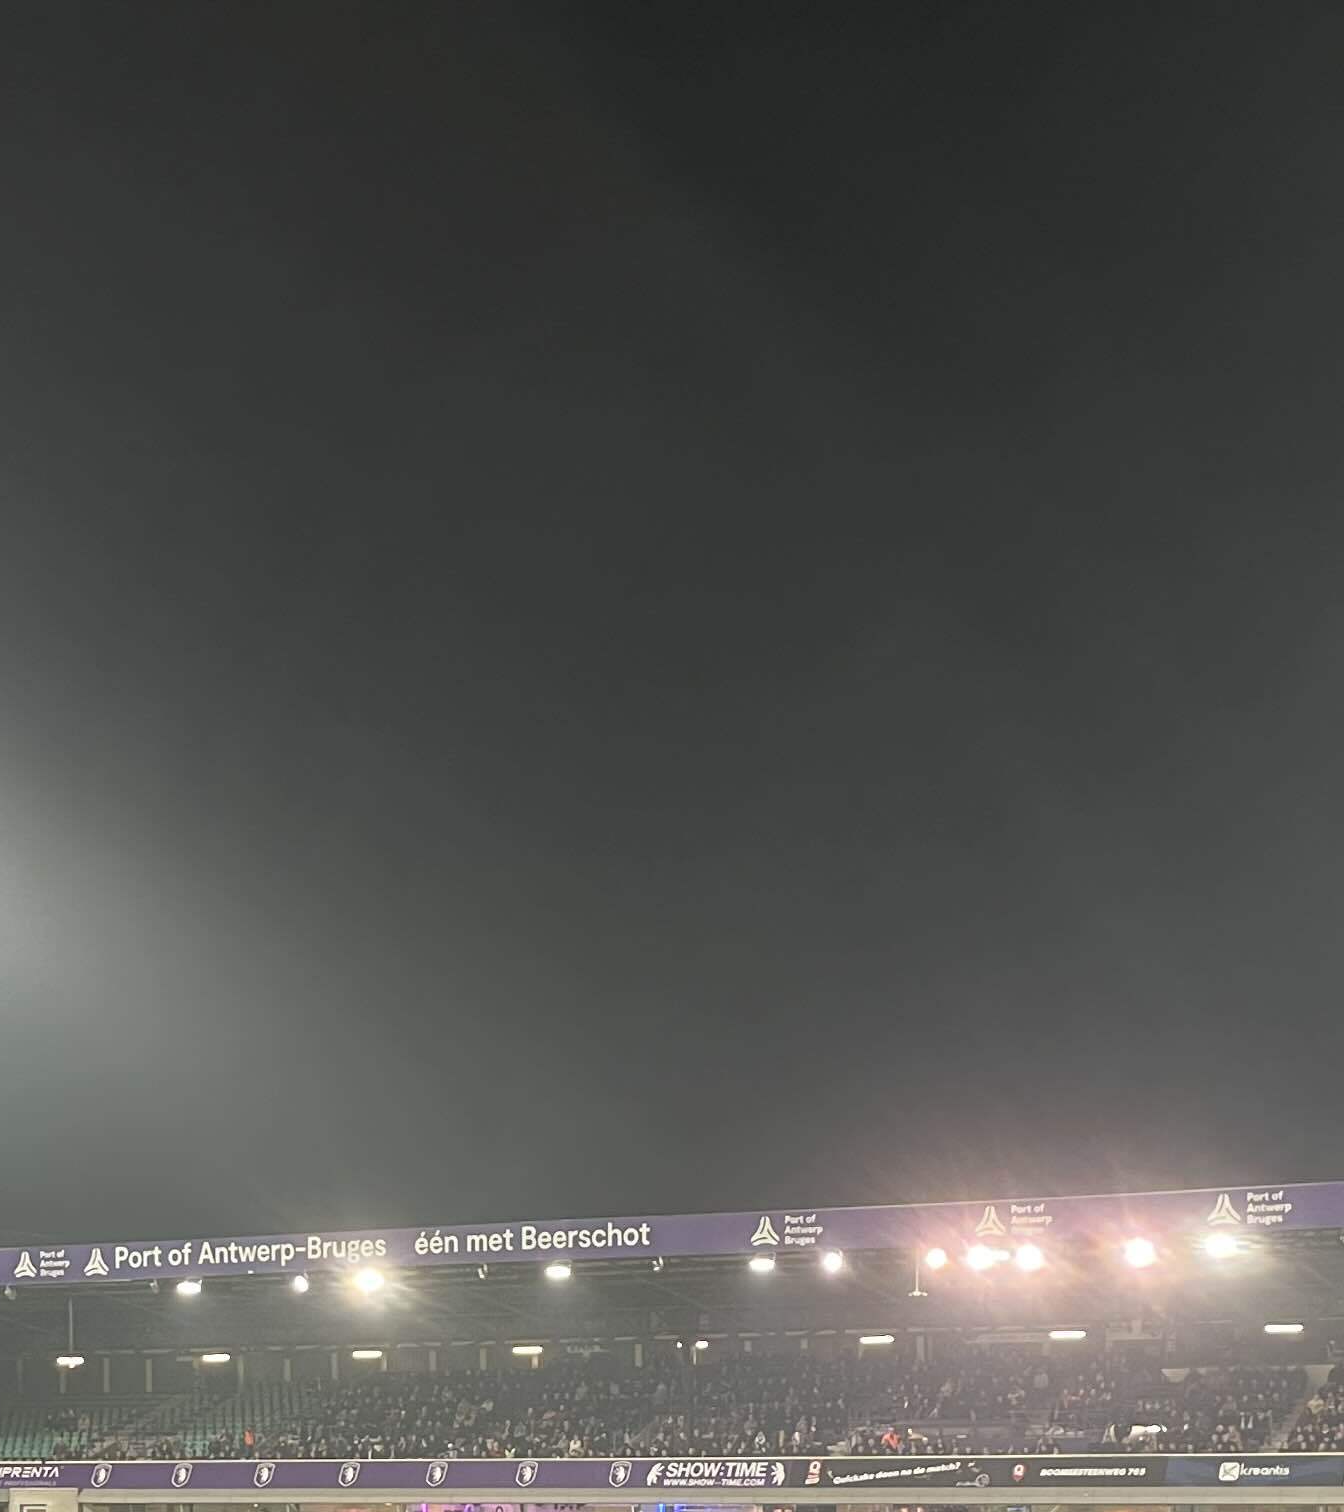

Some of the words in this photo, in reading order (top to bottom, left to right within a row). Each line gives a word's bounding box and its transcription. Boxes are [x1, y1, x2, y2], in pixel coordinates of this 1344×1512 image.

[1247, 1192, 1269, 1202] Port
[1271, 1190, 1284, 1201] of
[1010, 1204, 1032, 1214] Port
[1247, 1203, 1292, 1214] Antwerp
[785, 1215, 805, 1224] Port
[806, 1213, 816, 1224] of
[1247, 1214, 1283, 1226] Bruges
[784, 1225, 824, 1236] Antwerp
[415, 1232, 458, 1255] één
[466, 1229, 514, 1252] met
[521, 1222, 650, 1252] Beerschot
[785, 1236, 816, 1246] Bruges
[115, 1244, 163, 1269] Port
[168, 1242, 192, 1266] of
[198, 1235, 387, 1267] Antwerp-Bruges
[1239, 1463, 1290, 1476] kreantis
